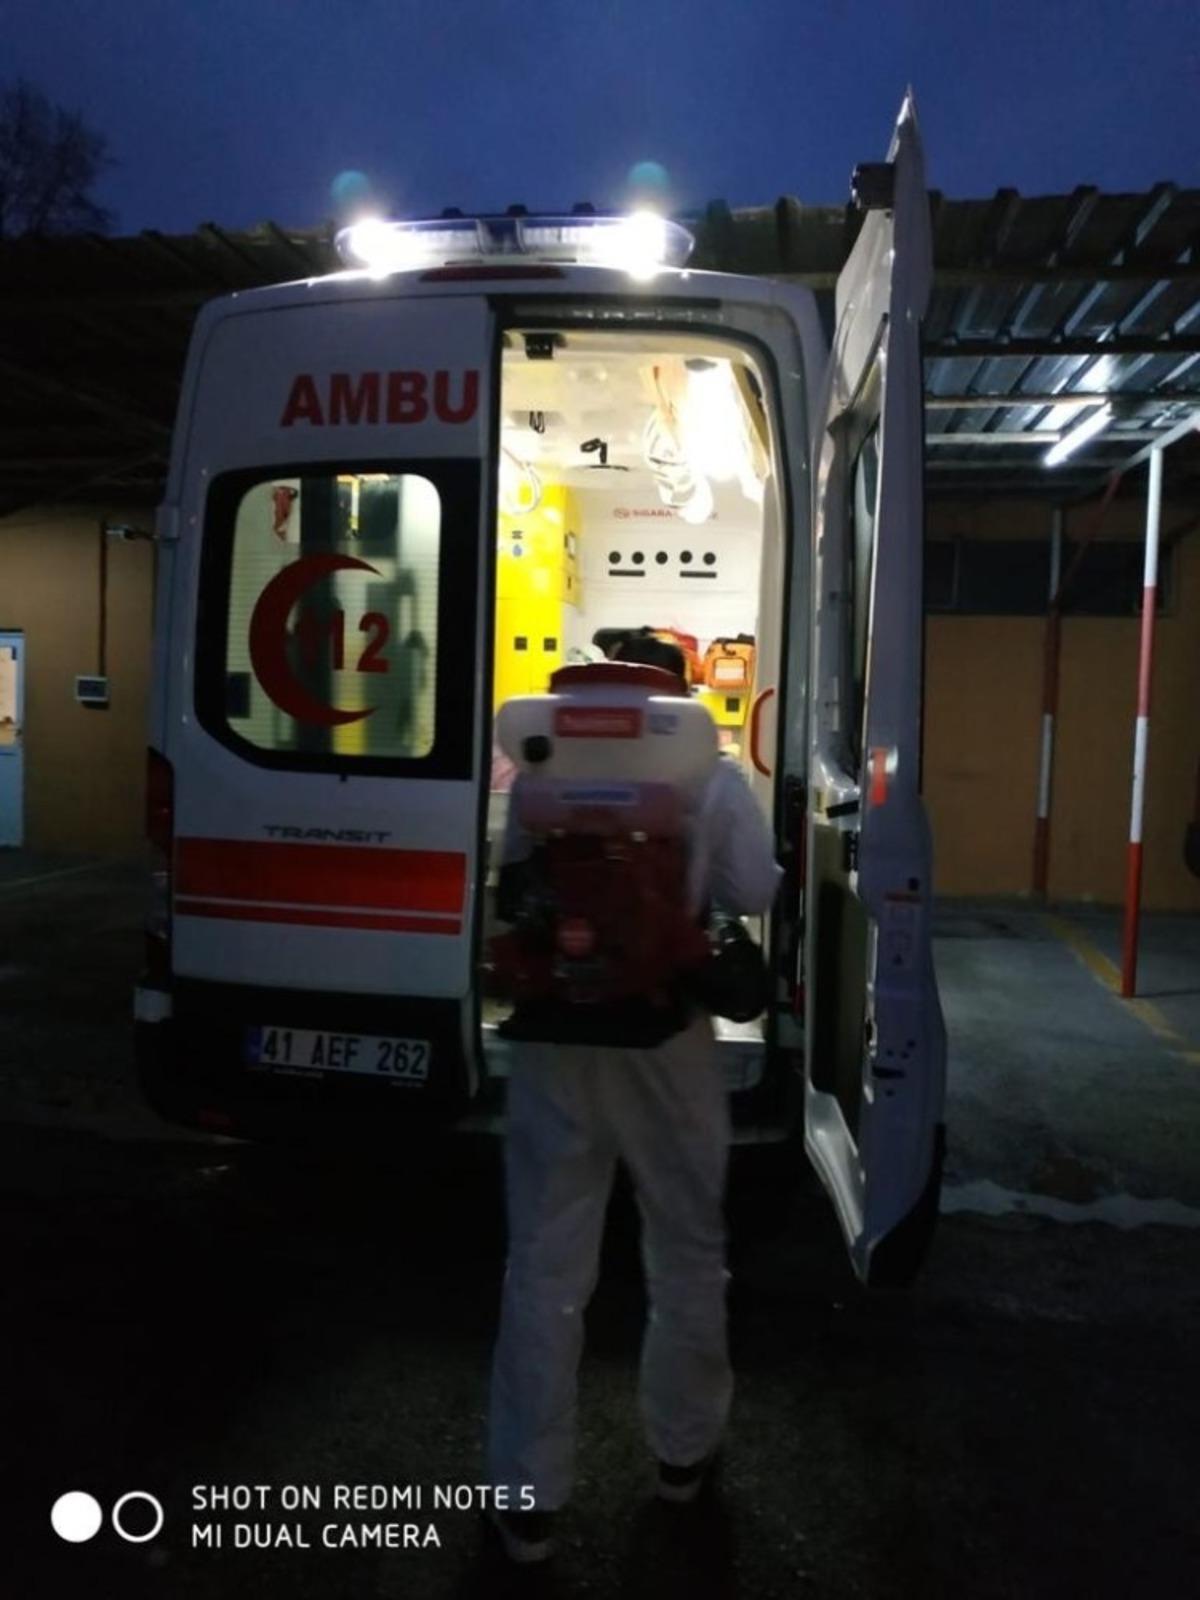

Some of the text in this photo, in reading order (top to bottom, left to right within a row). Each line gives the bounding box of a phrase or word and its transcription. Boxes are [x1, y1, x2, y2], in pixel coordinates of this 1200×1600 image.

[280, 370, 480, 427] AMBU
[297, 606, 390, 674] 112
[263, 825, 393, 844] TRANSIT
[264, 1030, 426, 1075] 41 AEF 262
